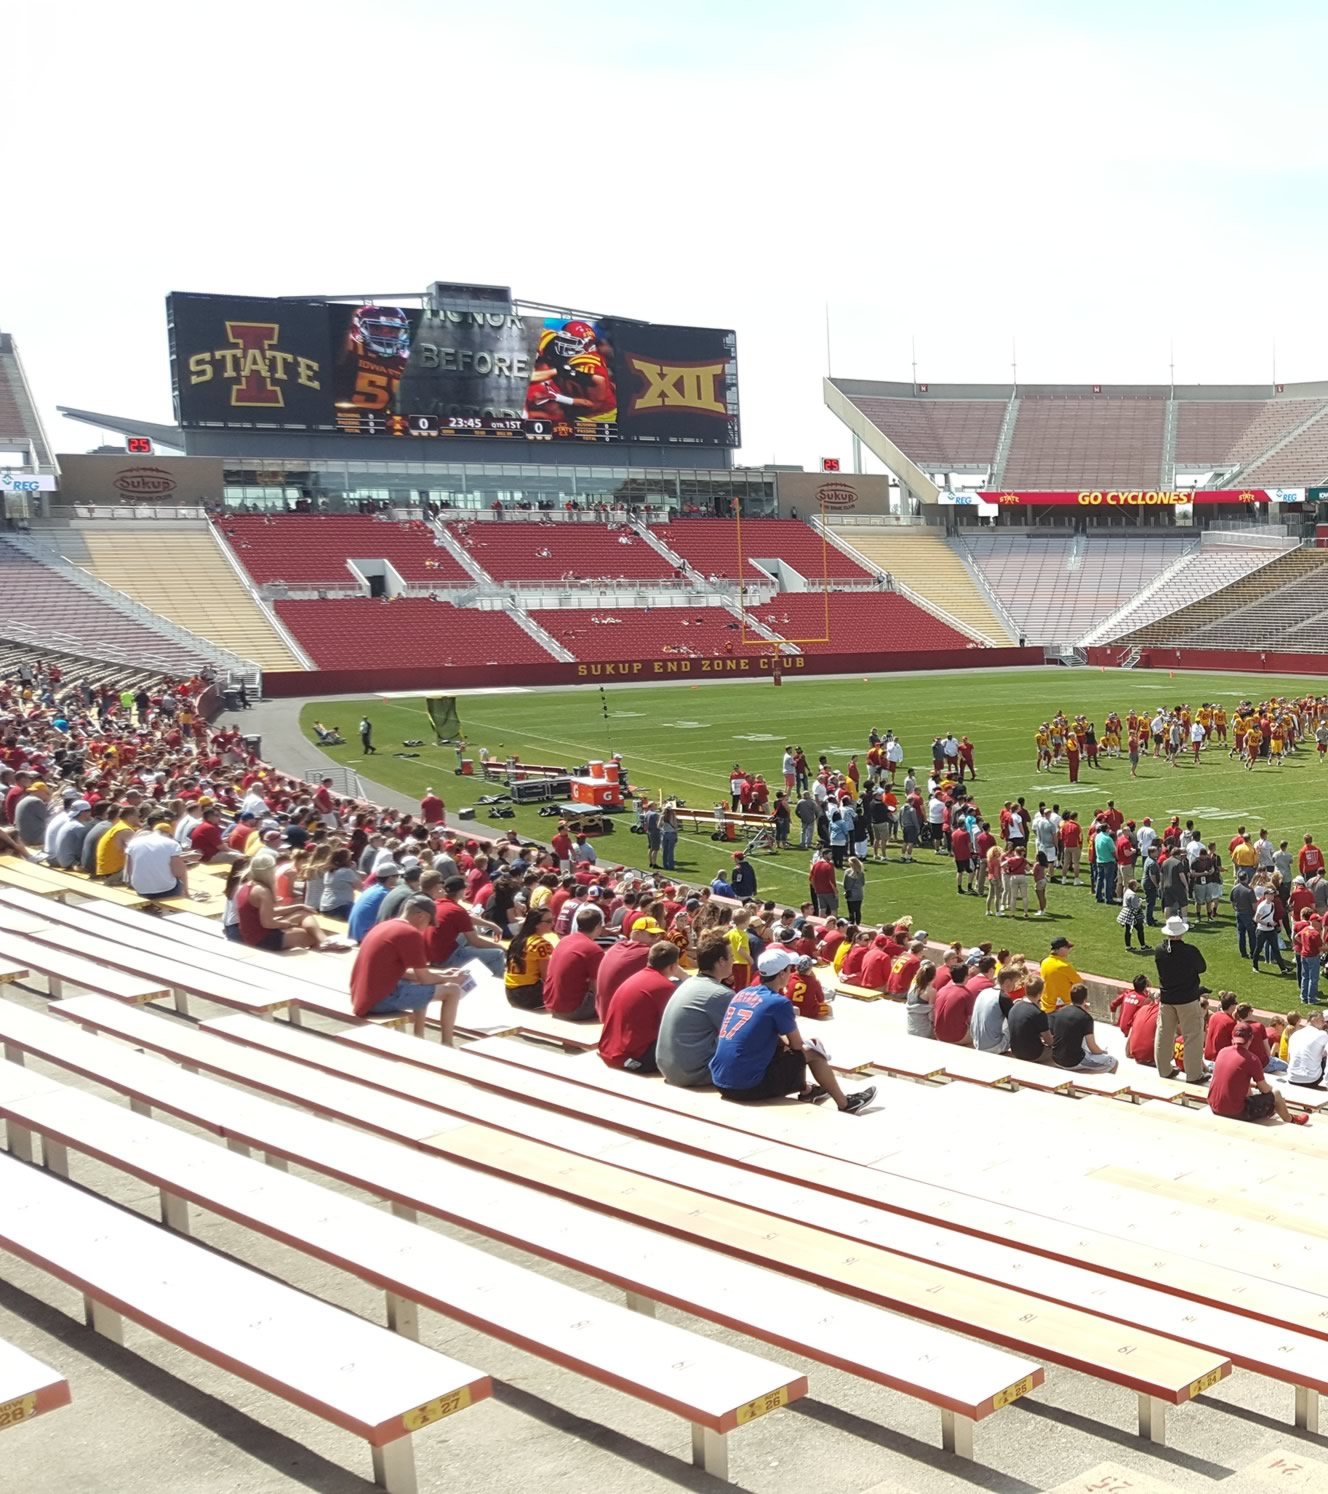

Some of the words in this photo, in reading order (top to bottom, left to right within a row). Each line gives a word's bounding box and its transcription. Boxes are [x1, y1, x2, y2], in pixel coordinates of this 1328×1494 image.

[419, 343, 530, 379] BEFORE
[189, 349, 321, 391] STATE
[631, 358, 727, 414] XII
[418, 418, 429, 429] 0
[449, 417, 482, 428] 23:45
[505, 421, 521, 430] 1ST
[534, 422, 543, 433] 0
[130, 438, 149, 452] 25
[824, 460, 839, 470] 25
[13, 480, 39, 491] REG
[120, 477, 170, 492] Sukup
[819, 489, 854, 502] Sukup
[955, 496, 971, 505] REG
[1078, 492, 1102, 505] GO
[1106, 490, 1196, 505] CYCLONES!
[1283, 493, 1297, 502] REG
[578, 663, 642, 676] SUKUP
[653, 661, 691, 673] END
[702, 659, 750, 671] ZONE
[603, 791, 612, 801] G
[792, 982, 807, 1003] 2
[719, 1006, 754, 1040] 17
[1015, 1384, 1027, 1397] 25
[441, 1398, 460, 1414] 27
[765, 1399, 781, 1411] 26
[0, 1407, 25, 1425] 28
